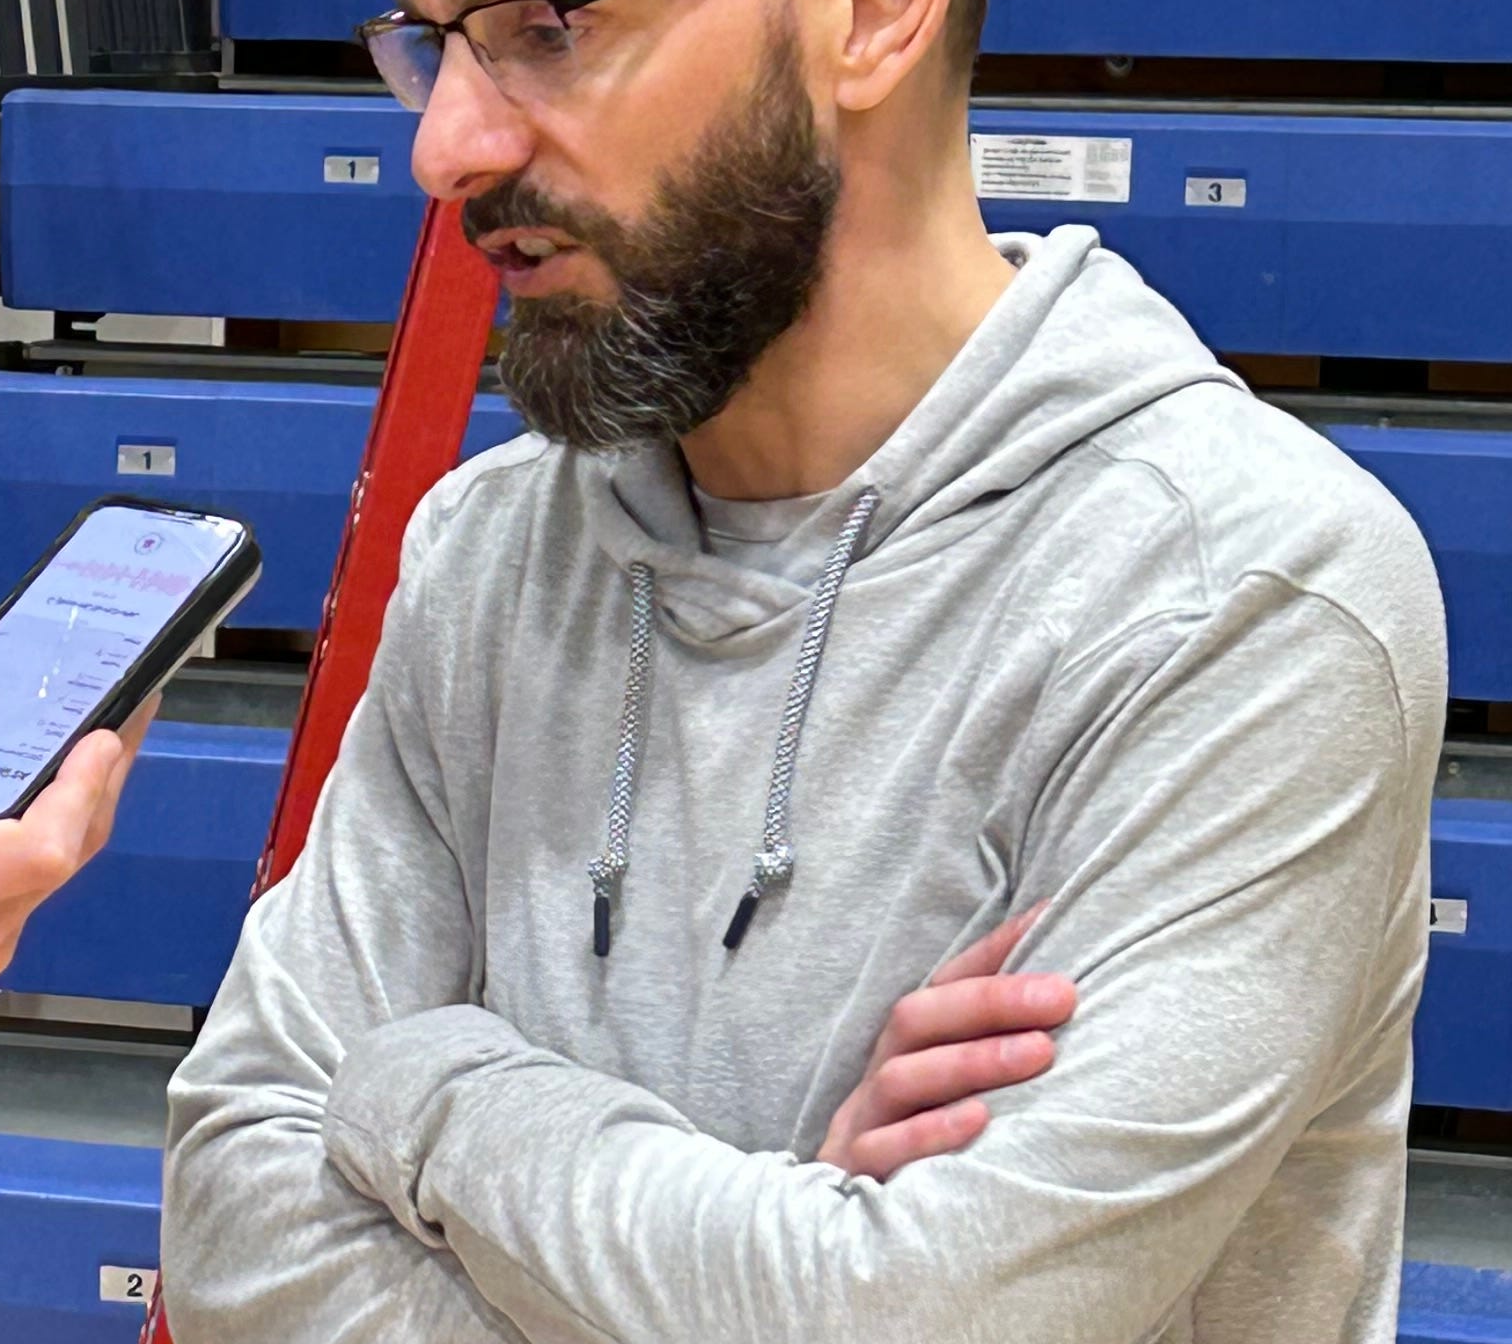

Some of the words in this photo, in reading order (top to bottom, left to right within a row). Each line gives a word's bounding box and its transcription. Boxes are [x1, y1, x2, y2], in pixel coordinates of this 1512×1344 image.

[347, 160, 356, 180] 1
[1208, 182, 1222, 203] 3
[142, 450, 152, 471] 1
[126, 1273, 144, 1297] 2
